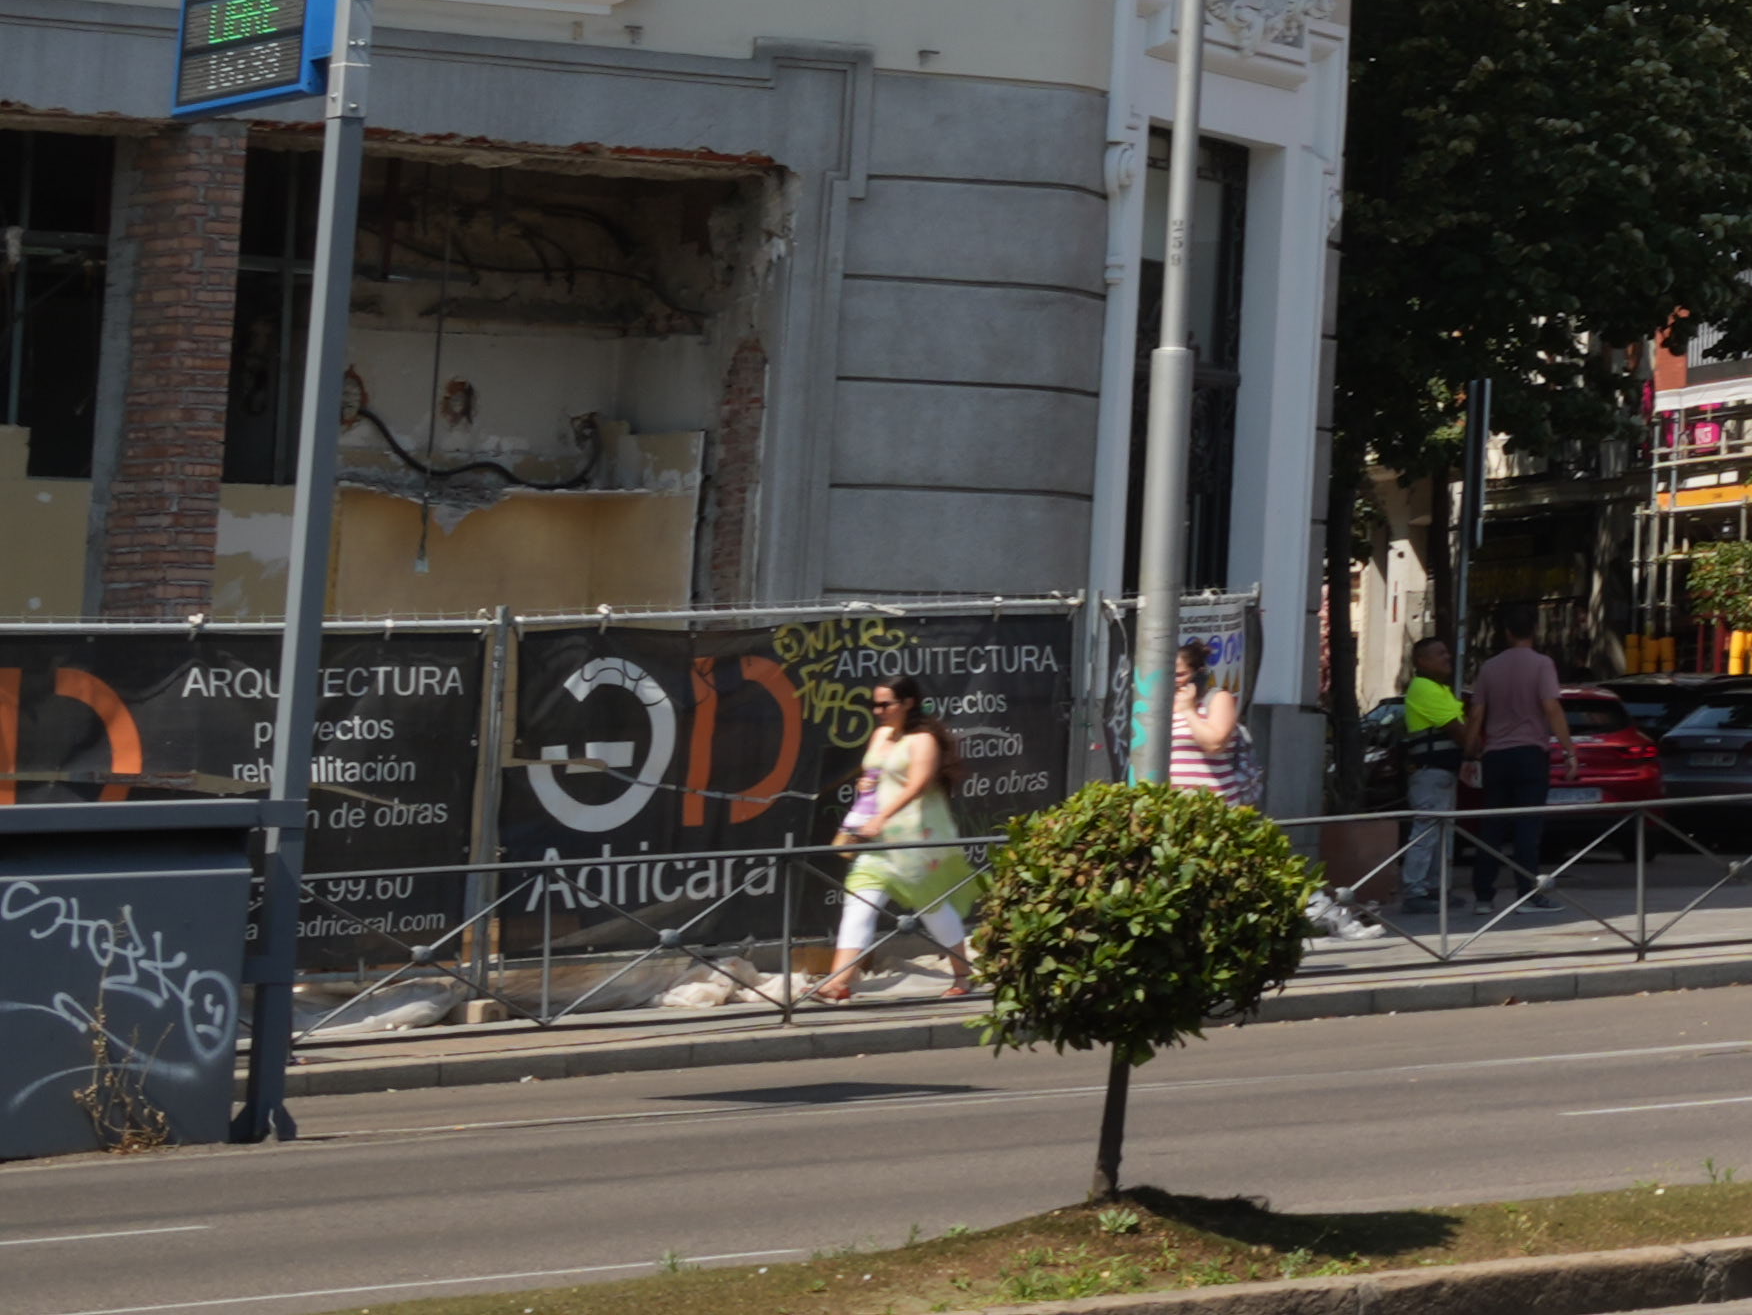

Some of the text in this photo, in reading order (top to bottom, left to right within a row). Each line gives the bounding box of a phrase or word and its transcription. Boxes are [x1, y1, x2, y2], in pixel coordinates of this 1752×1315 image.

[834, 645, 1059, 679] ARQUITECTURA
[963, 770, 1048, 798] de obras
[329, 801, 366, 830] de
[374, 797, 449, 827] obras
